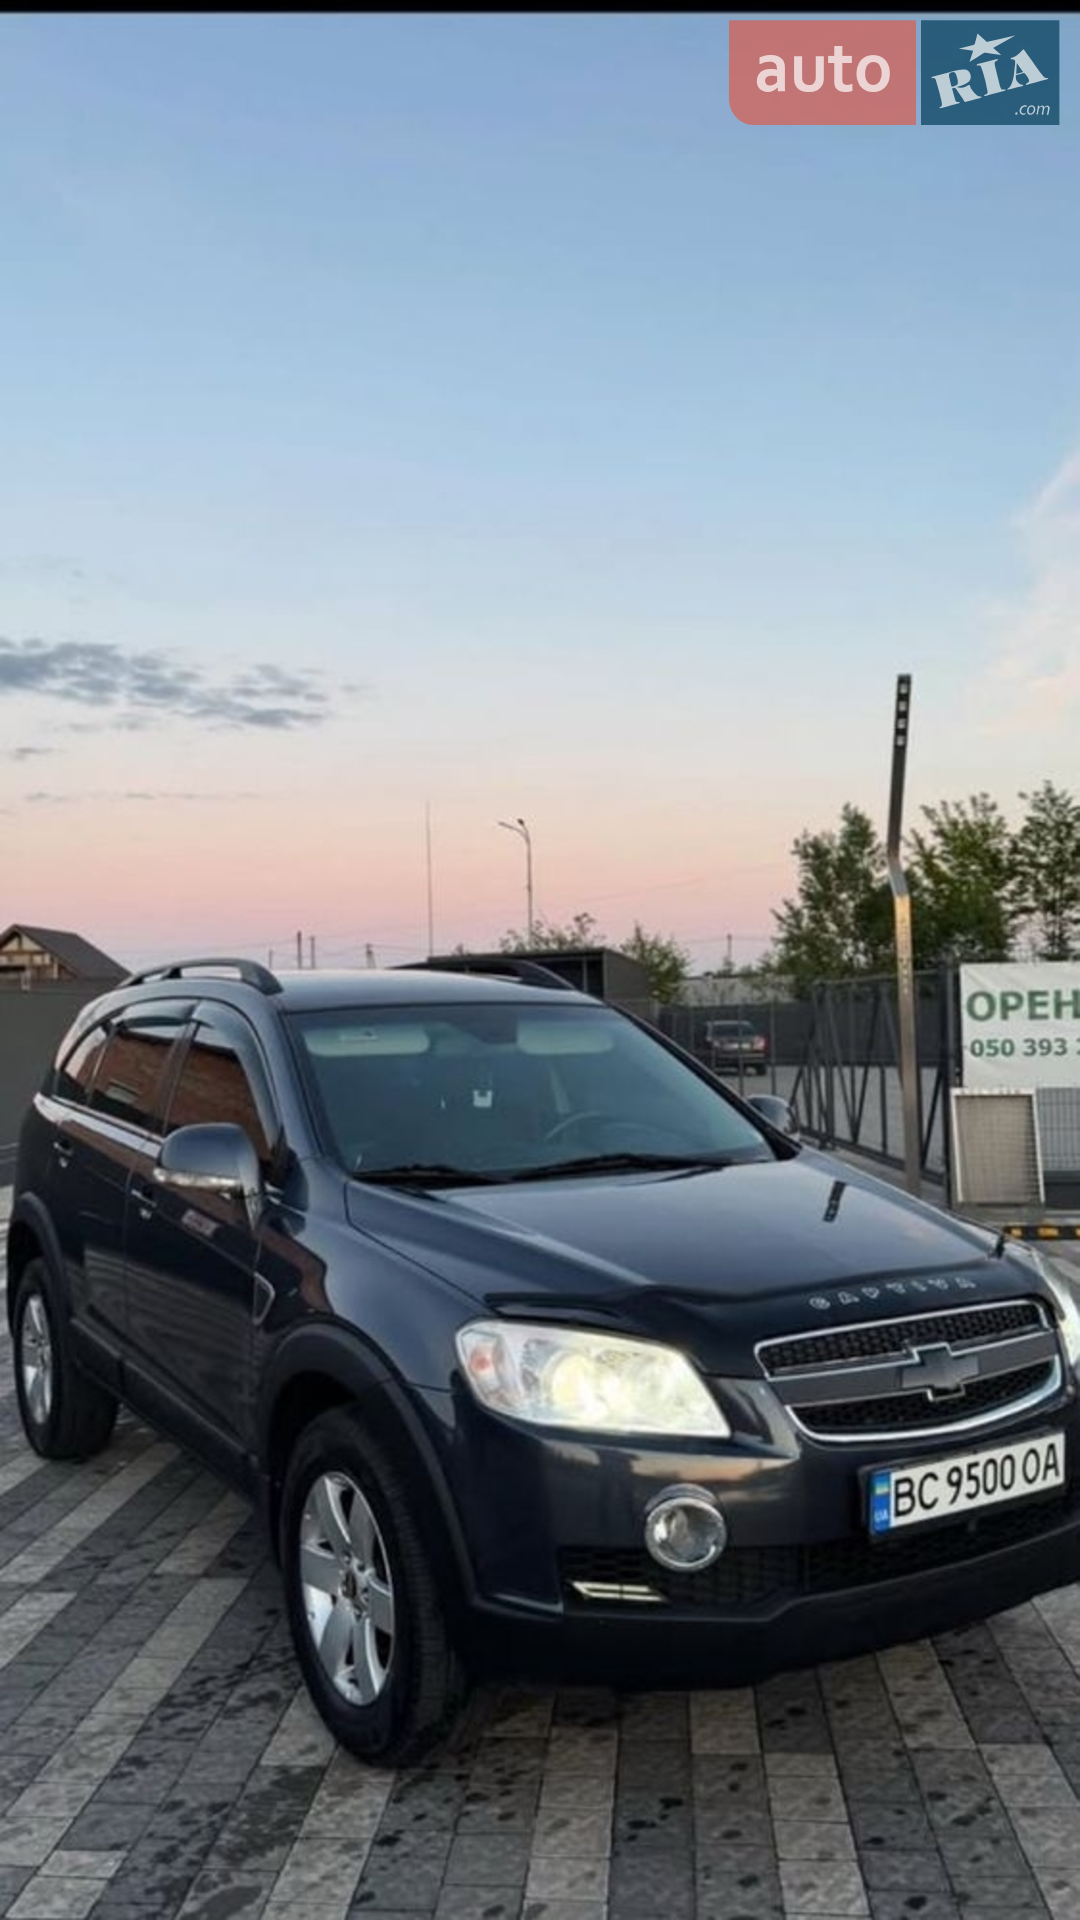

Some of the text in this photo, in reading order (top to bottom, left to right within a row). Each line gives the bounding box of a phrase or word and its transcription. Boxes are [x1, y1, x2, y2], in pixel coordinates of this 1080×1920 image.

[970, 1038, 1015, 1058] 050
[1022, 1037, 1068, 1057] 393
[894, 1443, 1060, 1518] BC 9500 OA
